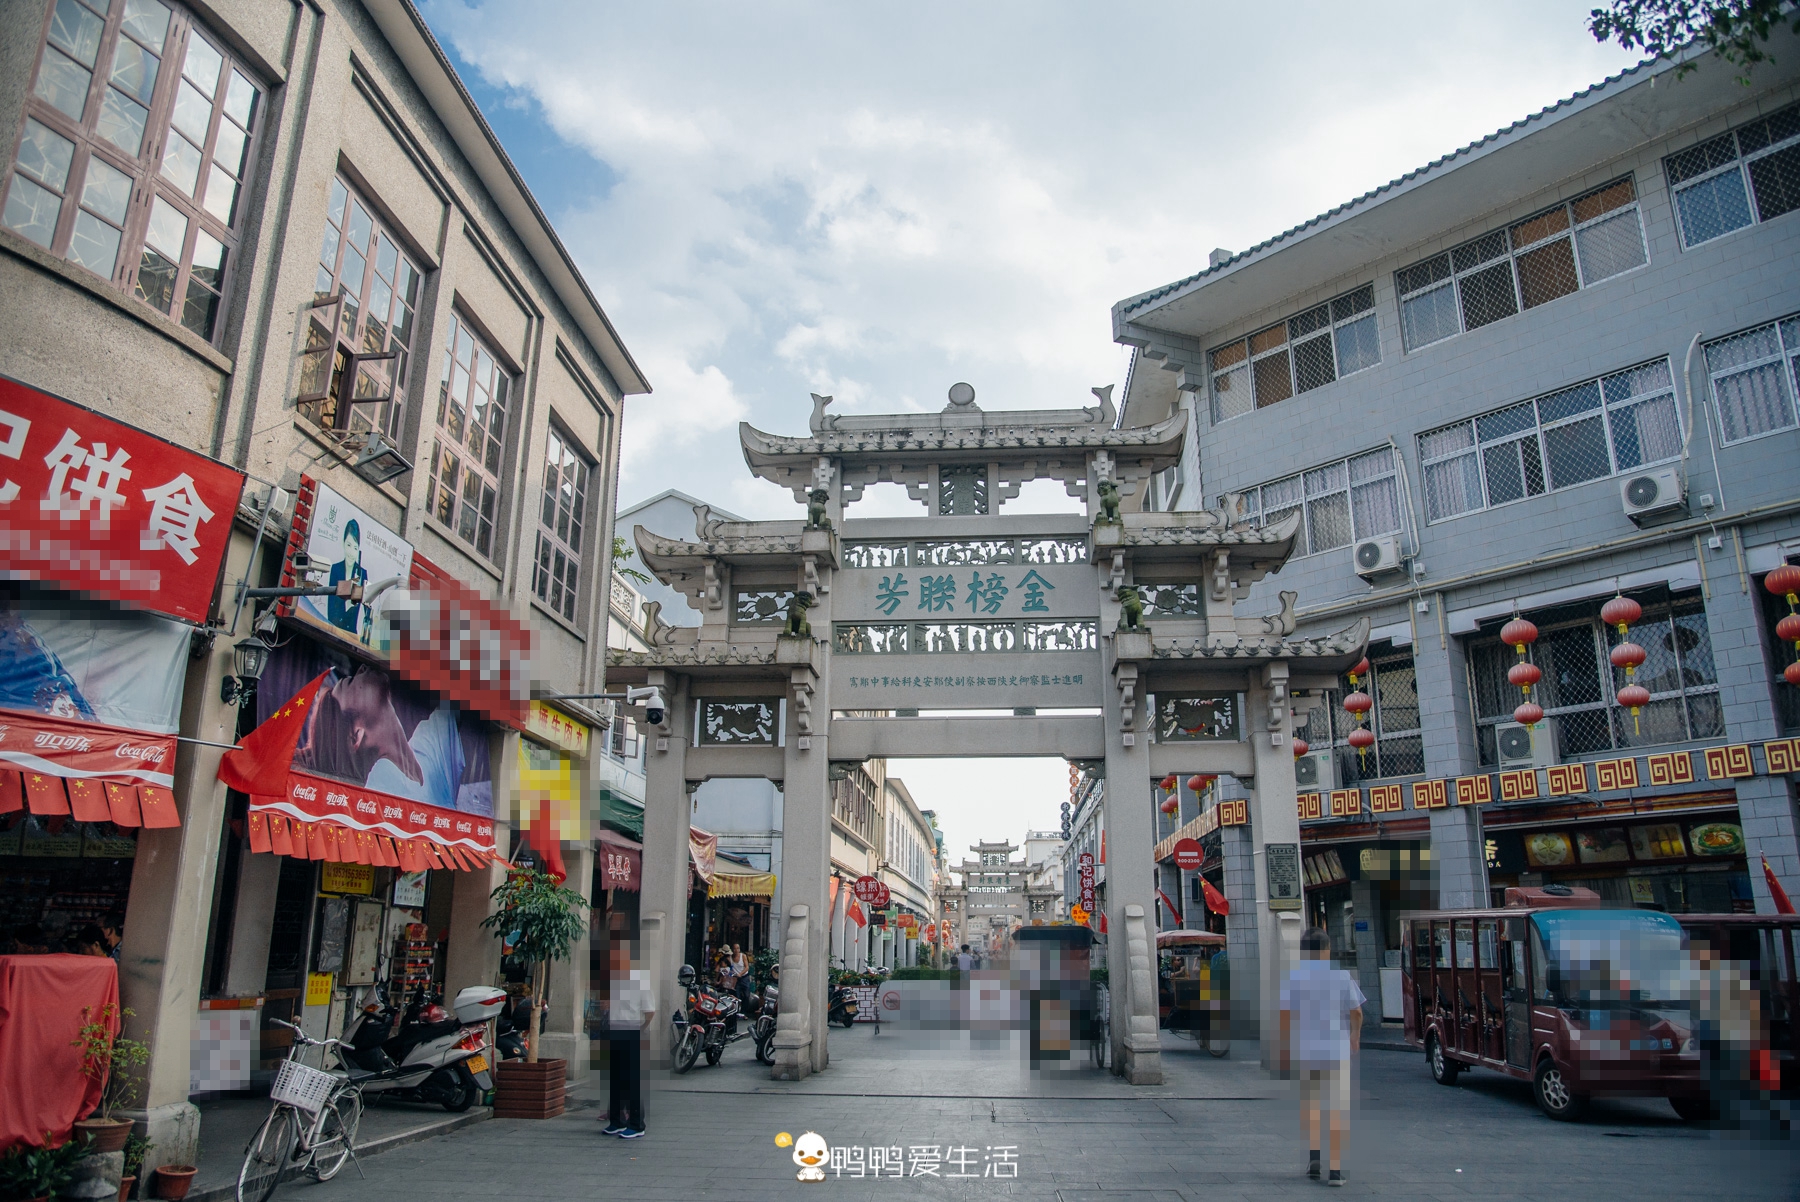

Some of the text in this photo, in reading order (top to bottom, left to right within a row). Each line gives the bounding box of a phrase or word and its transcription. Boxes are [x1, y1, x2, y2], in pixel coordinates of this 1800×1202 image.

[34, 731, 95, 752] 可口可乐
[326, 792, 350, 807] 可口可乐
[1081, 855, 1094, 911] 和记饼食店
